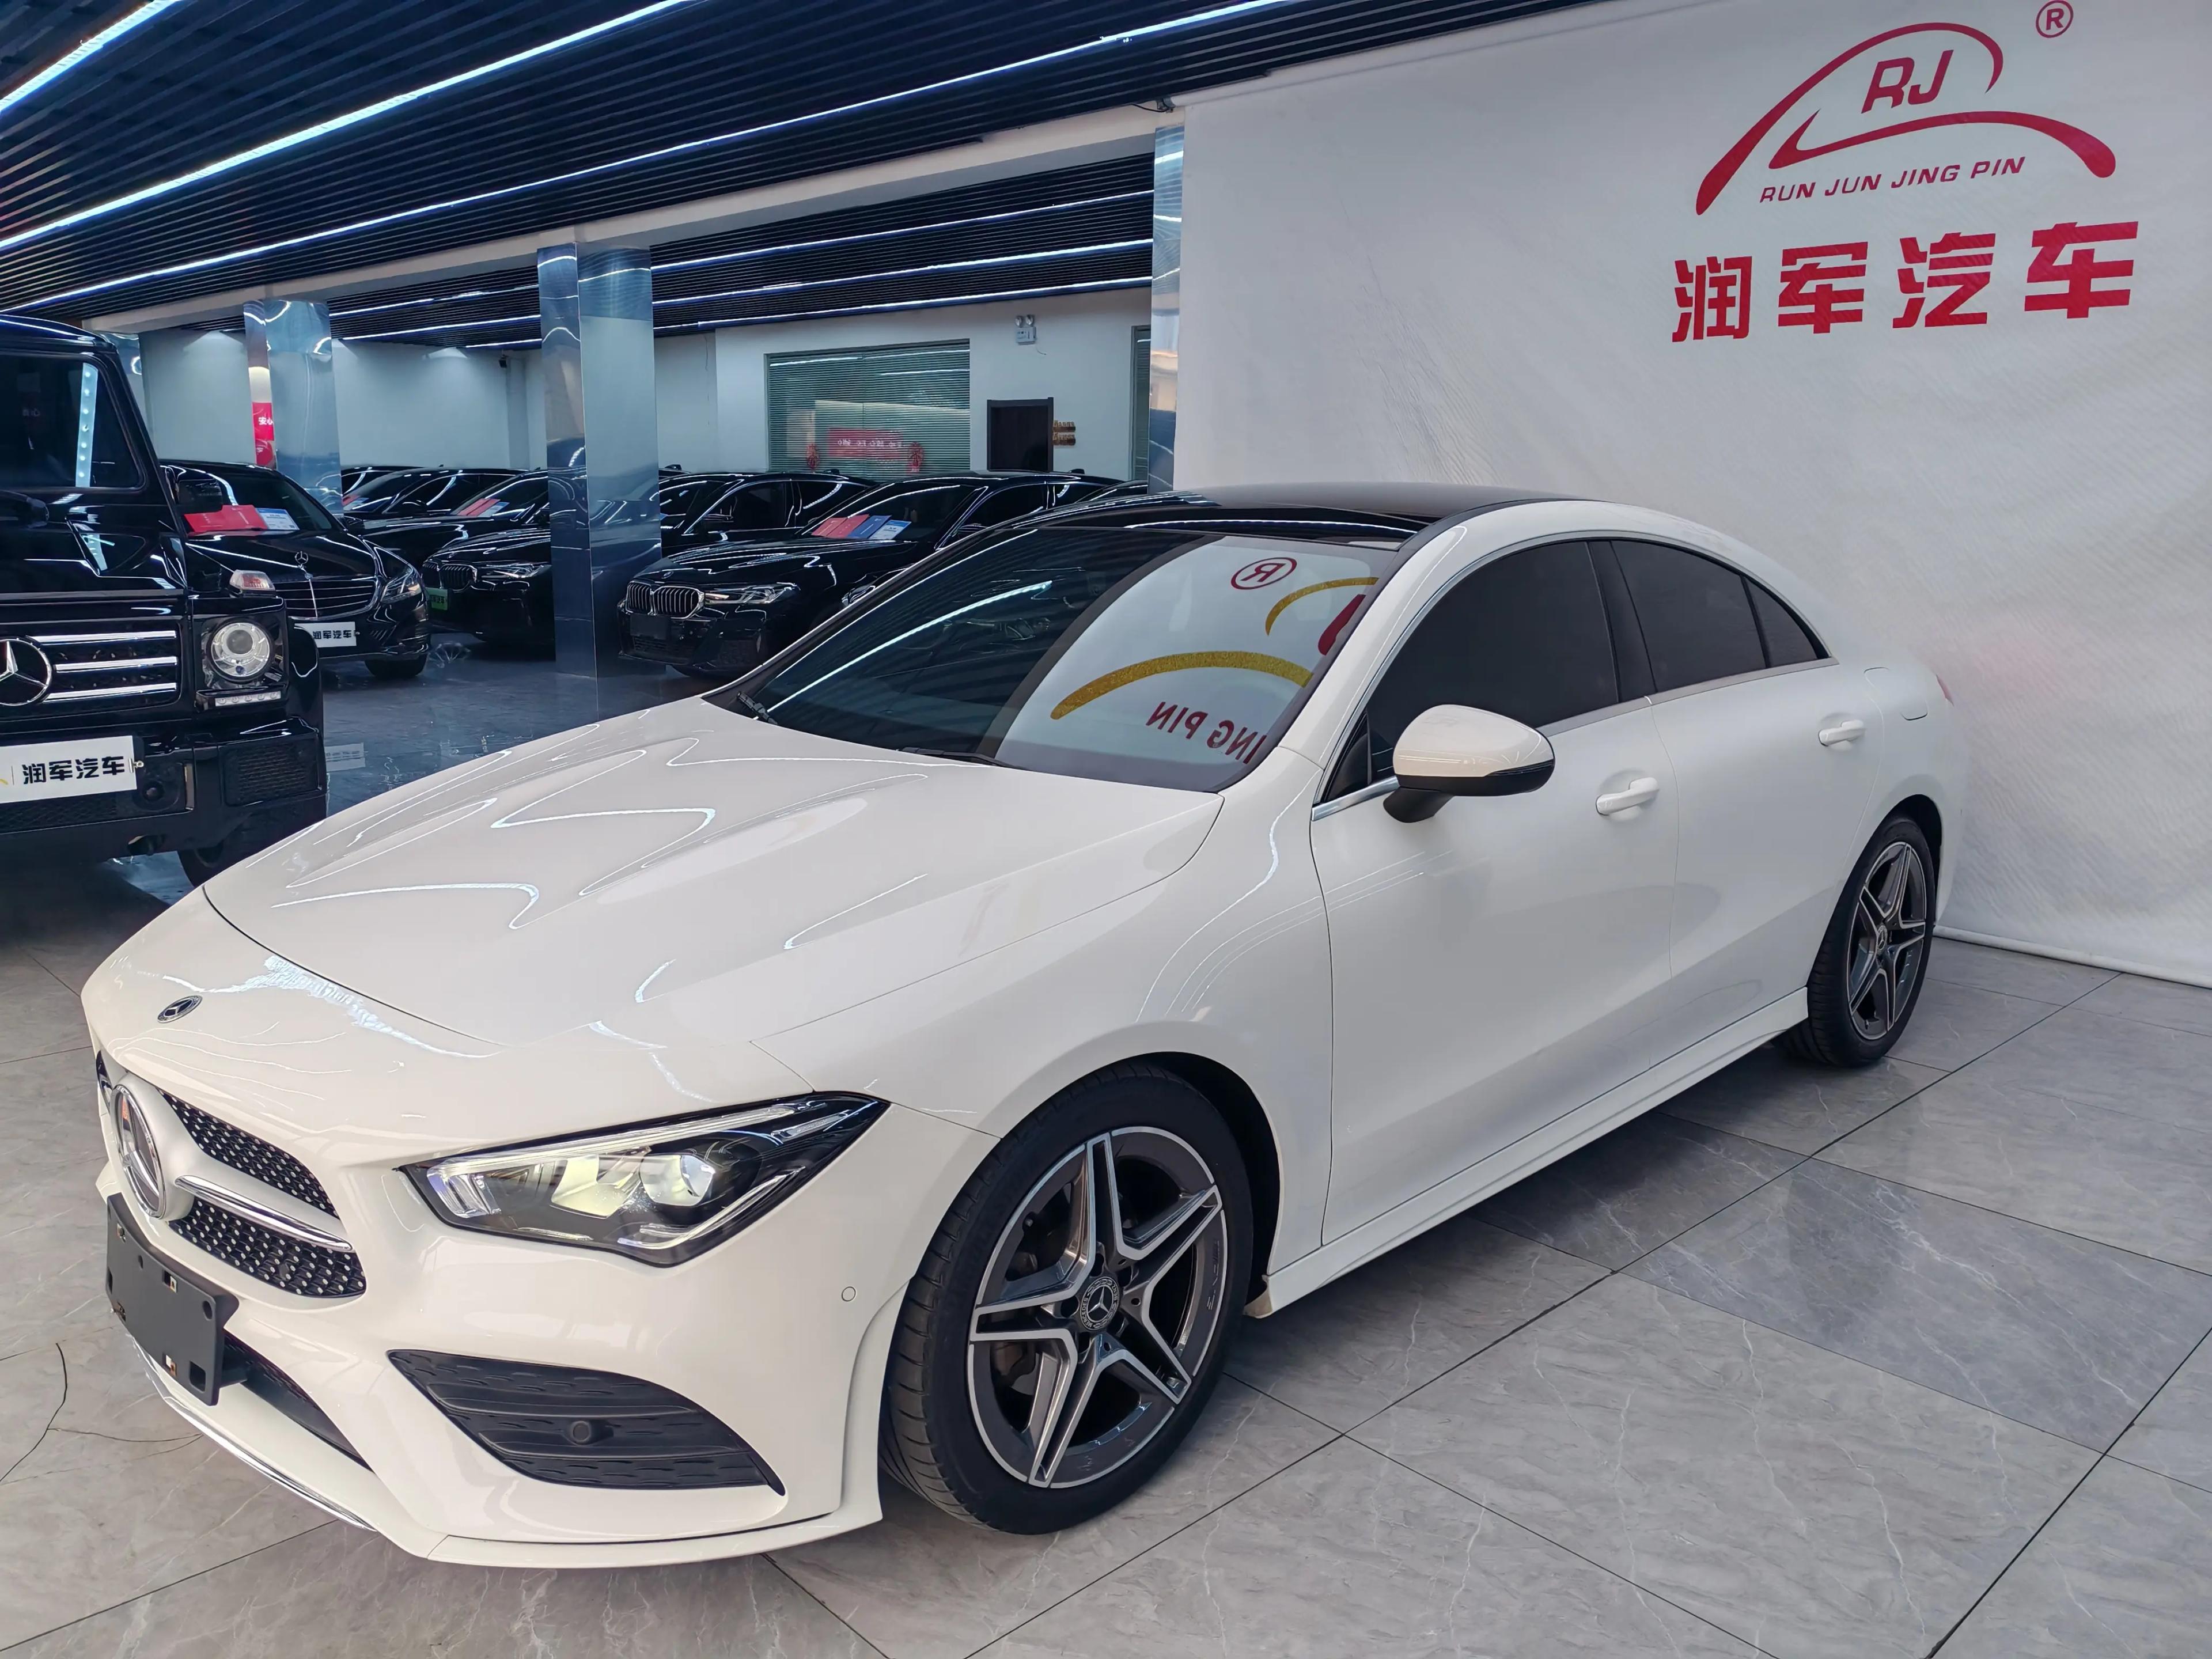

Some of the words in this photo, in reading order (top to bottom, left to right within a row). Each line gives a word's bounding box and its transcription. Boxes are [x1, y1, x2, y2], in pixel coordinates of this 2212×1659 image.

[1861, 50, 1954, 113] RJ
[1759, 182, 1816, 203] RUN
[1825, 174, 1882, 196] JUN
[1891, 165, 1960, 189] JING
[1970, 156, 2026, 179] PIN
[1672, 221, 2139, 343] 润军汽车
[312, 630, 352, 640] 润军汽车
[22, 756, 125, 785] 润军汽车
